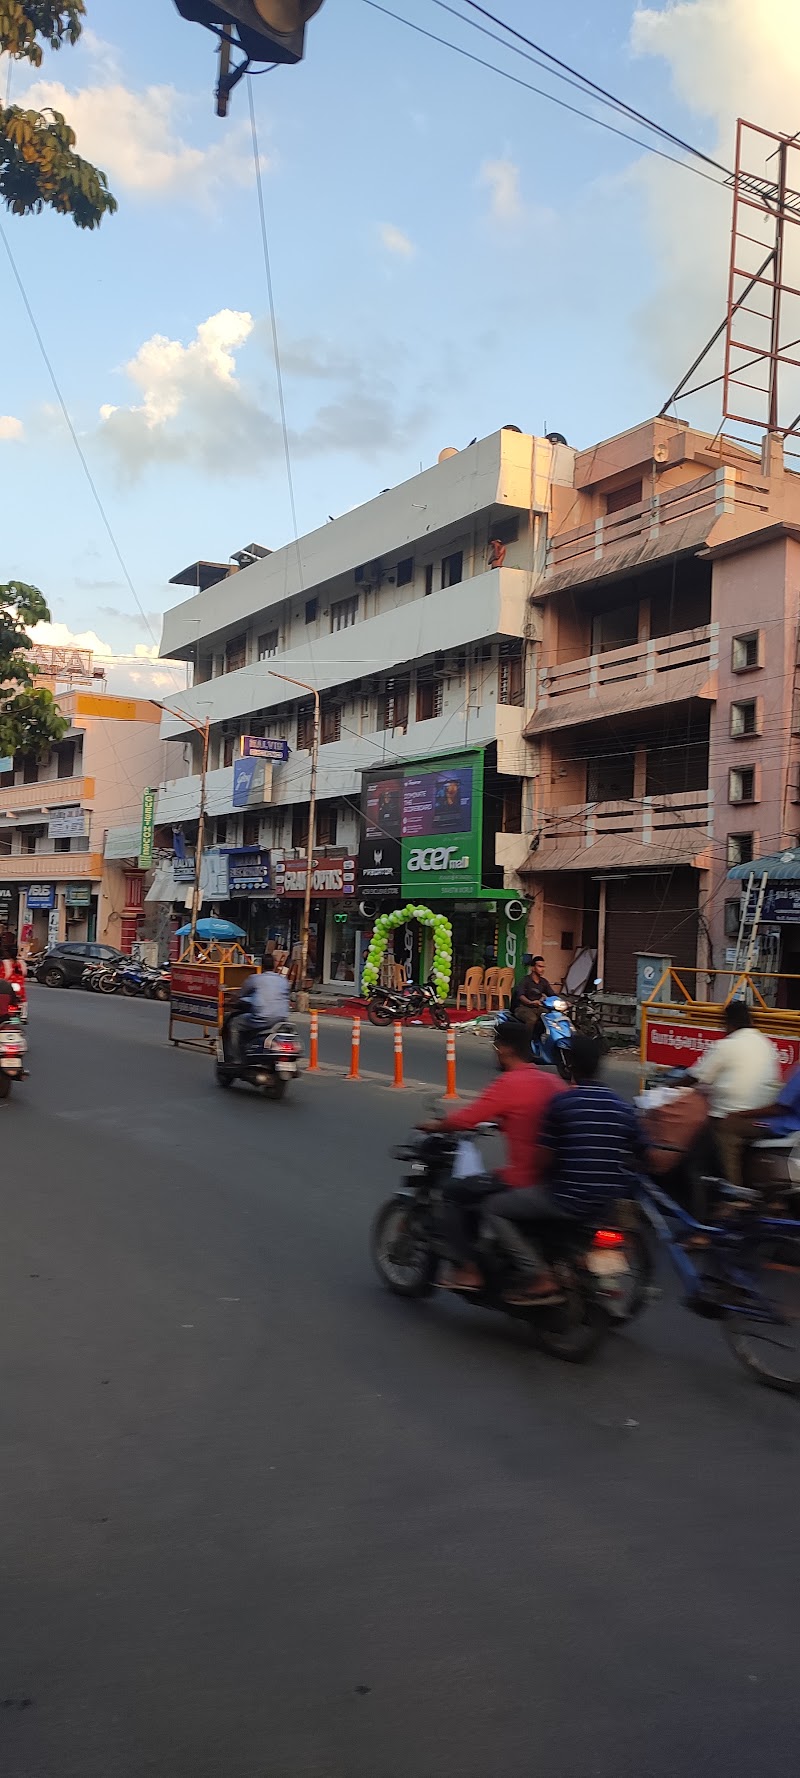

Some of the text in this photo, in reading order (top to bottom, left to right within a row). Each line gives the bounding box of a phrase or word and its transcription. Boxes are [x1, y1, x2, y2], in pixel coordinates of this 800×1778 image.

[407, 846, 459, 871] acer
[284, 871, 313, 891] GRAN
[313, 869, 342, 891] OPTICS
[505, 923, 516, 969] cer
